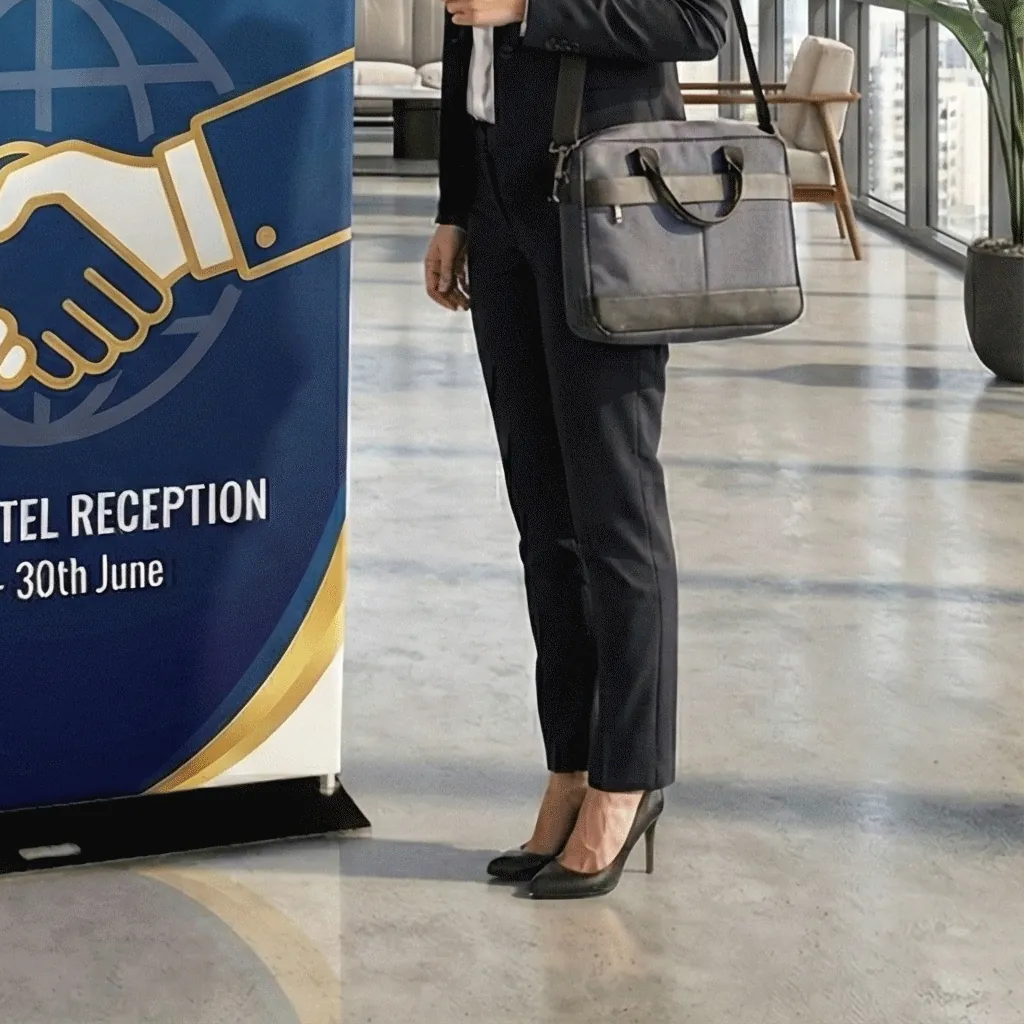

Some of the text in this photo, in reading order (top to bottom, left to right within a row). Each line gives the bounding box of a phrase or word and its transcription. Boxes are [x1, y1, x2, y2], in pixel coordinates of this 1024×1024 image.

[71, 478, 268, 536] RECEPTION
[16, 559, 87, 600] 30th
[95, 554, 164, 594] June
